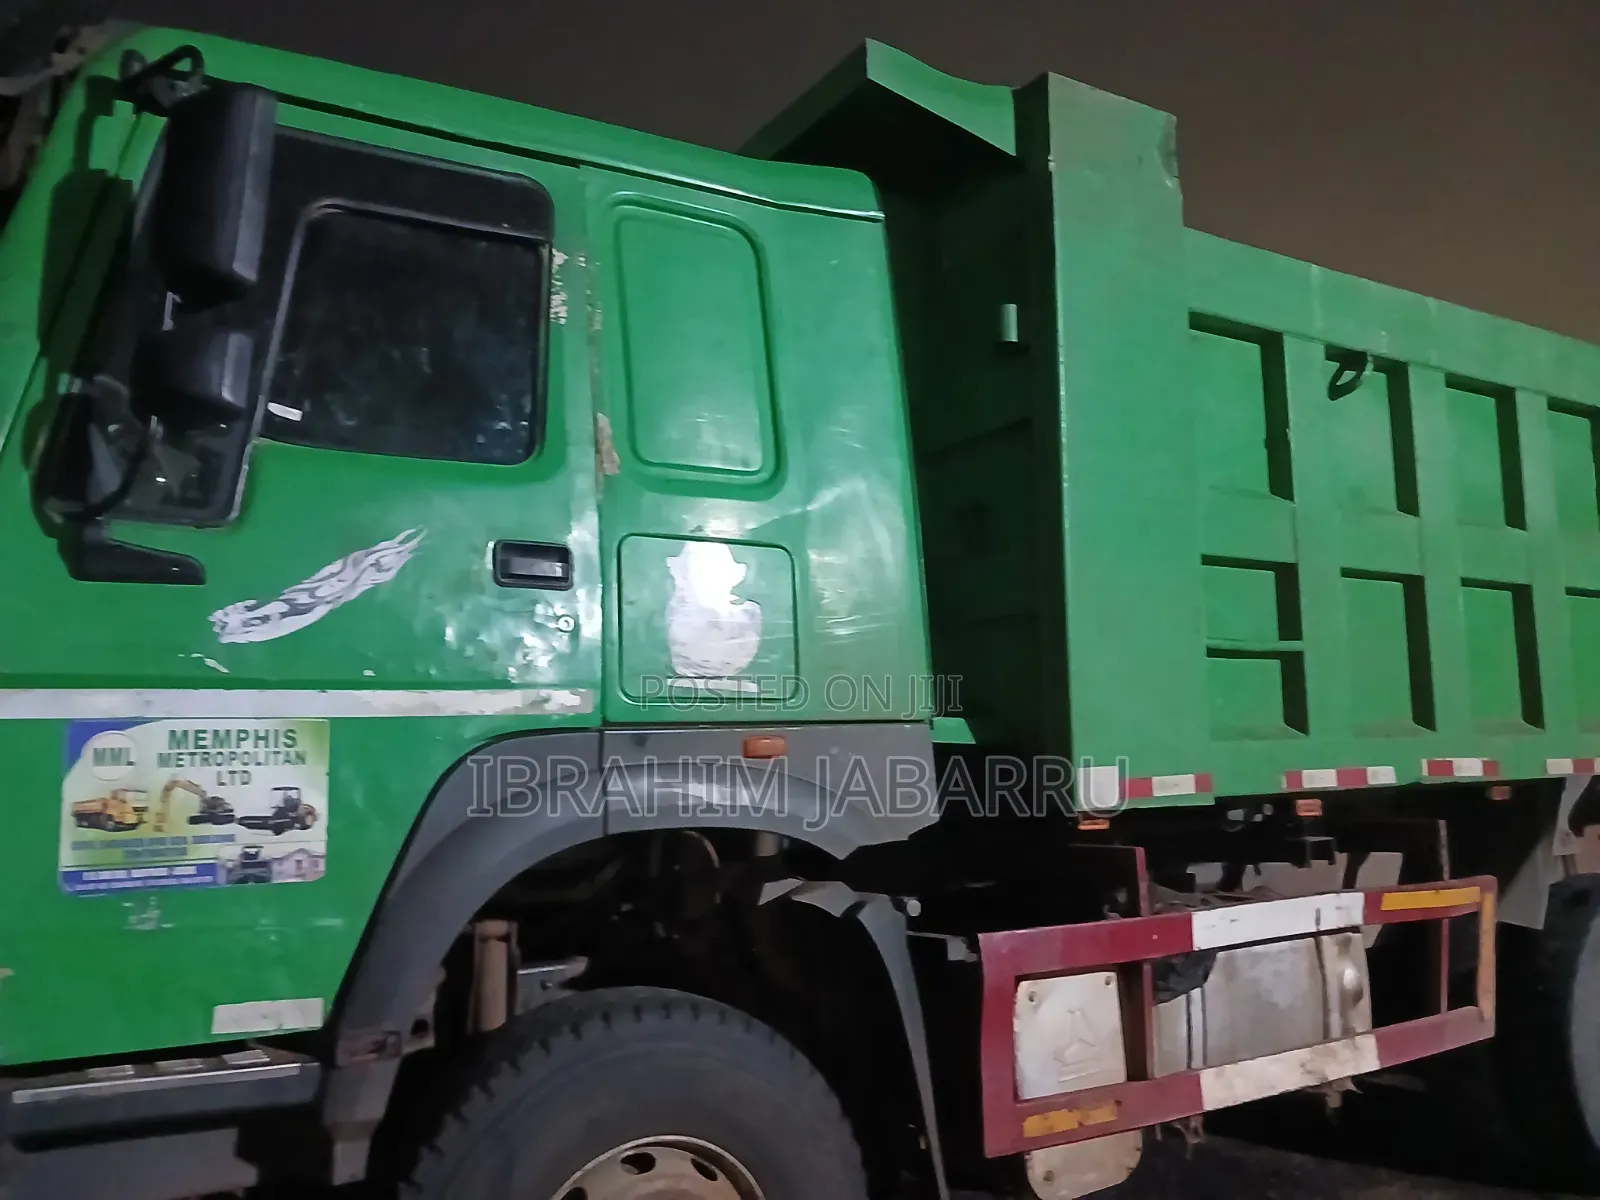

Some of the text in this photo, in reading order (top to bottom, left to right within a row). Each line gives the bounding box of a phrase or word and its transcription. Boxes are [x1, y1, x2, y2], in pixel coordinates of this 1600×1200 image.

[168, 728, 298, 750] MEMPHIS
[92, 747, 135, 767] MML
[157, 750, 307, 768] METROPOLITAN
[216, 769, 252, 787] LTD
